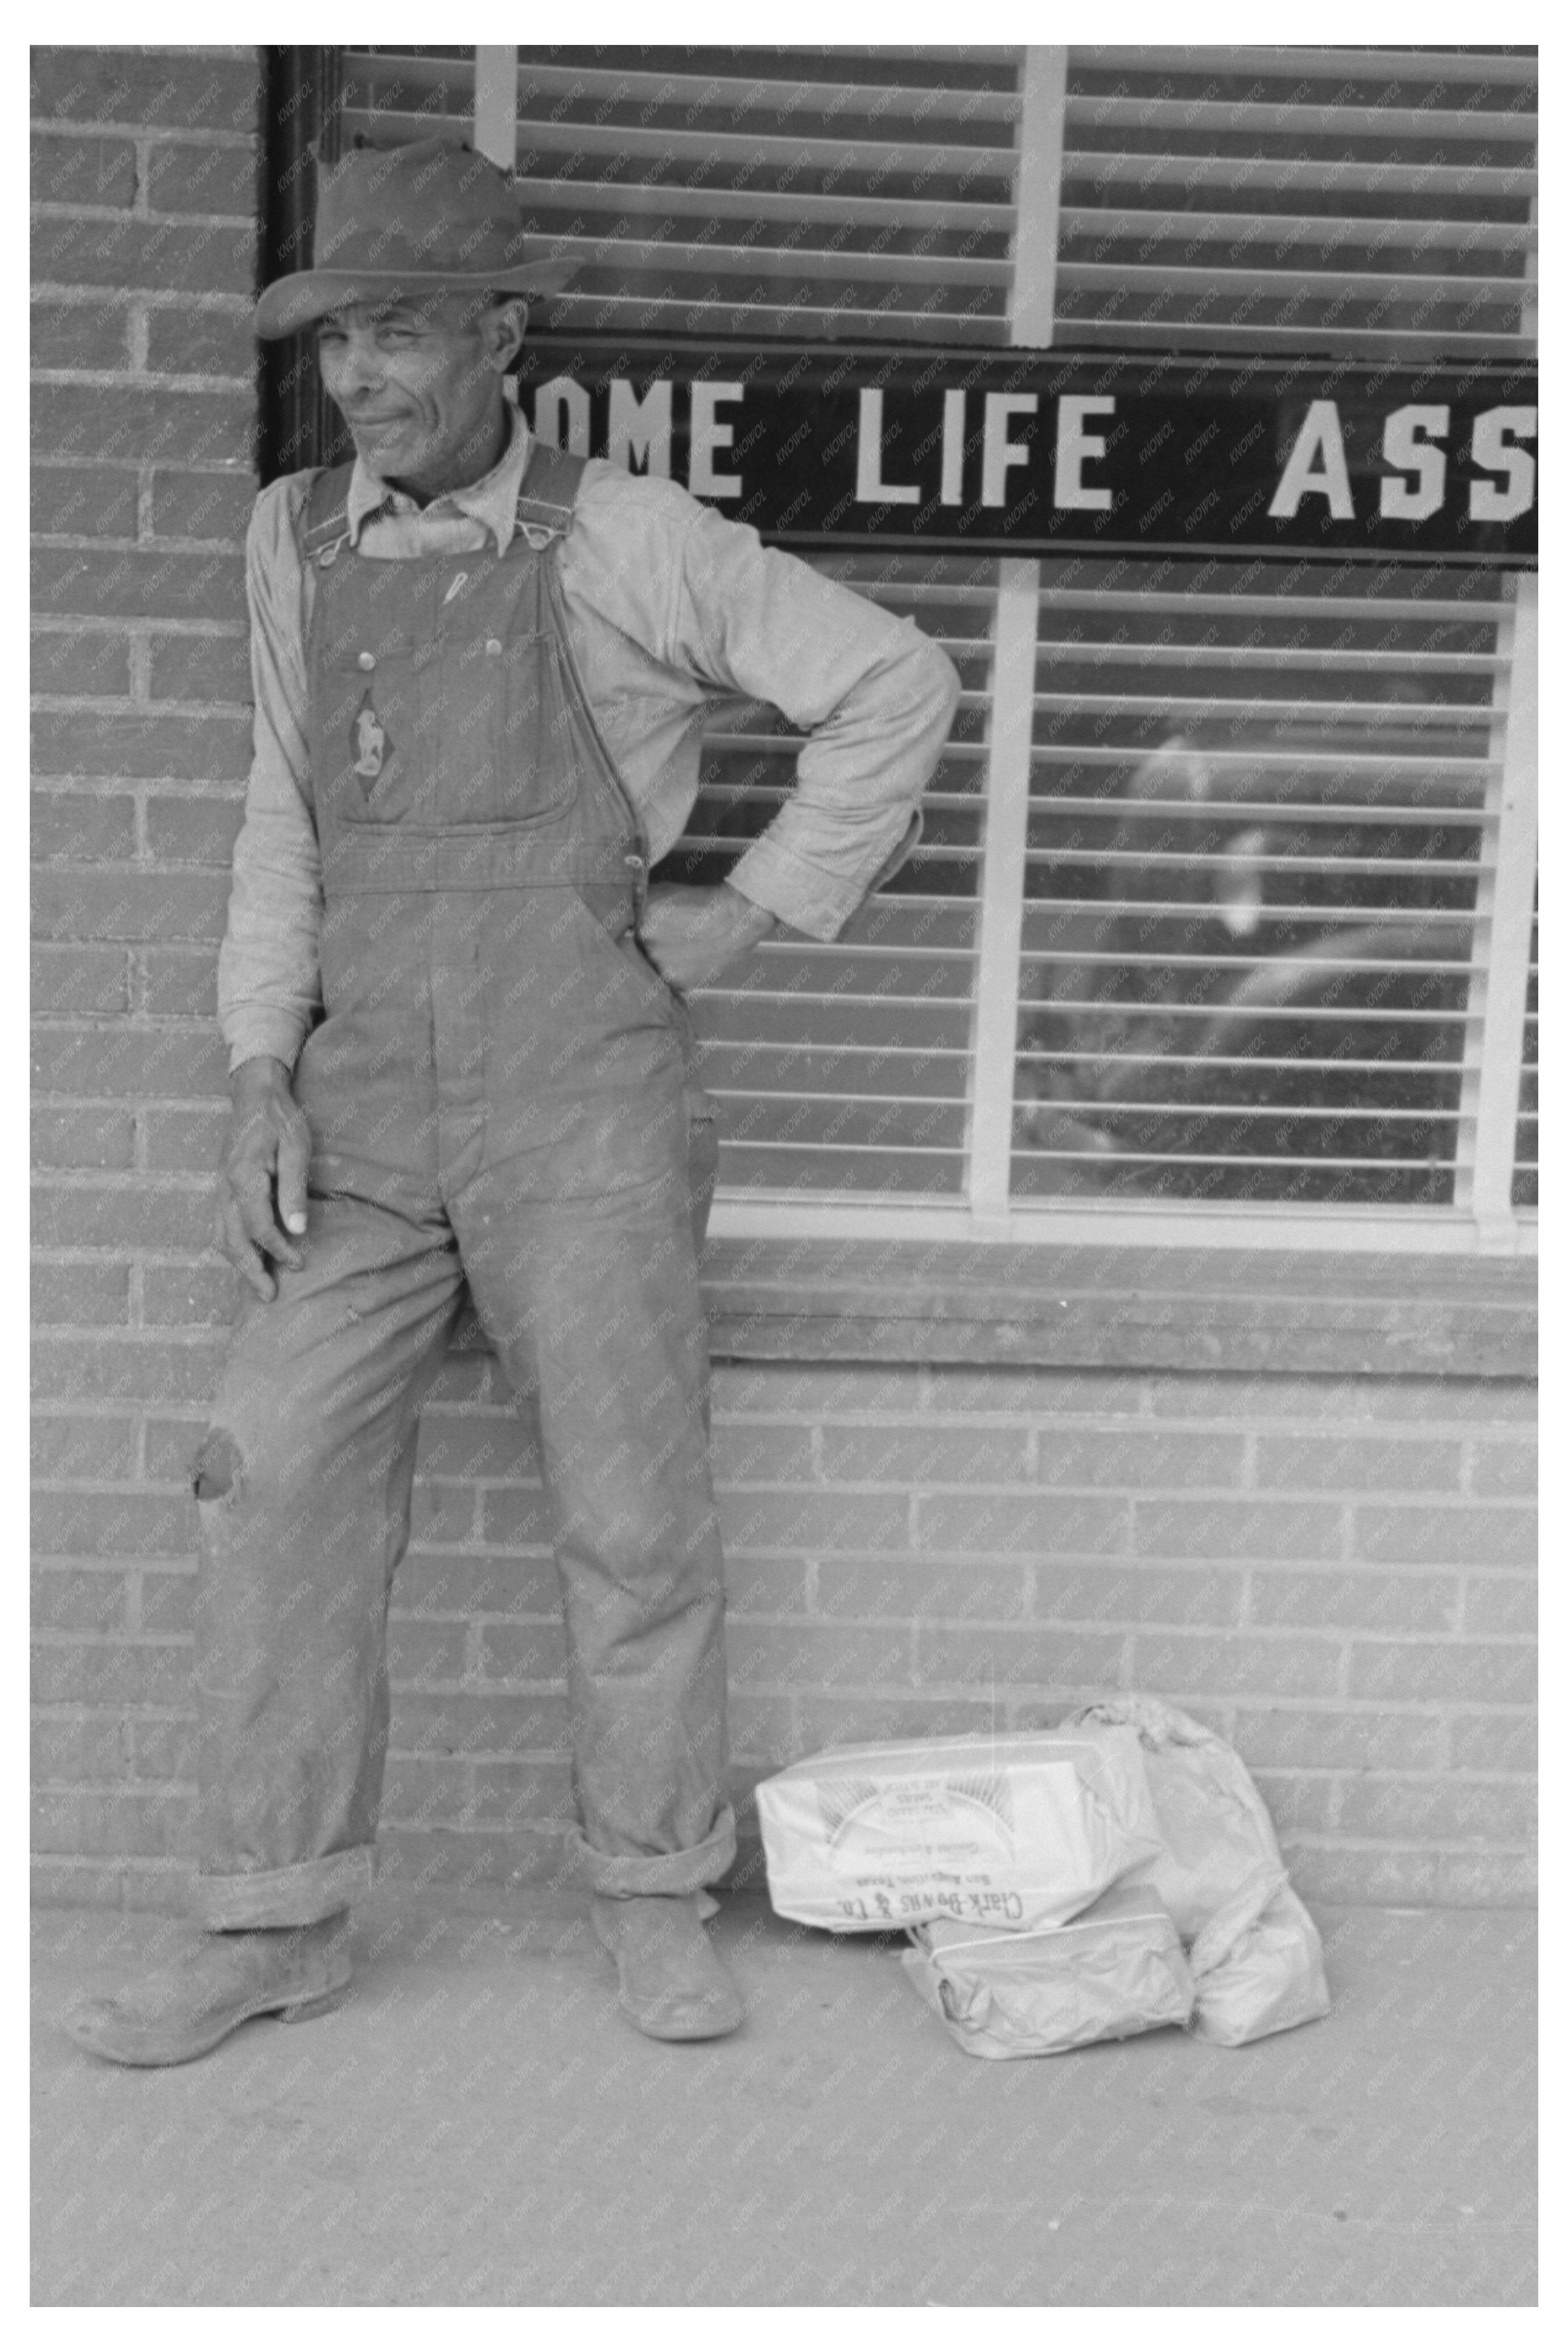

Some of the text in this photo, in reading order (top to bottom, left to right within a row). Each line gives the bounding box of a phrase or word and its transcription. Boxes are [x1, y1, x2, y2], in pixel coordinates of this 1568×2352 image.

[503, 374, 1538, 522] OME LIFE ASS
